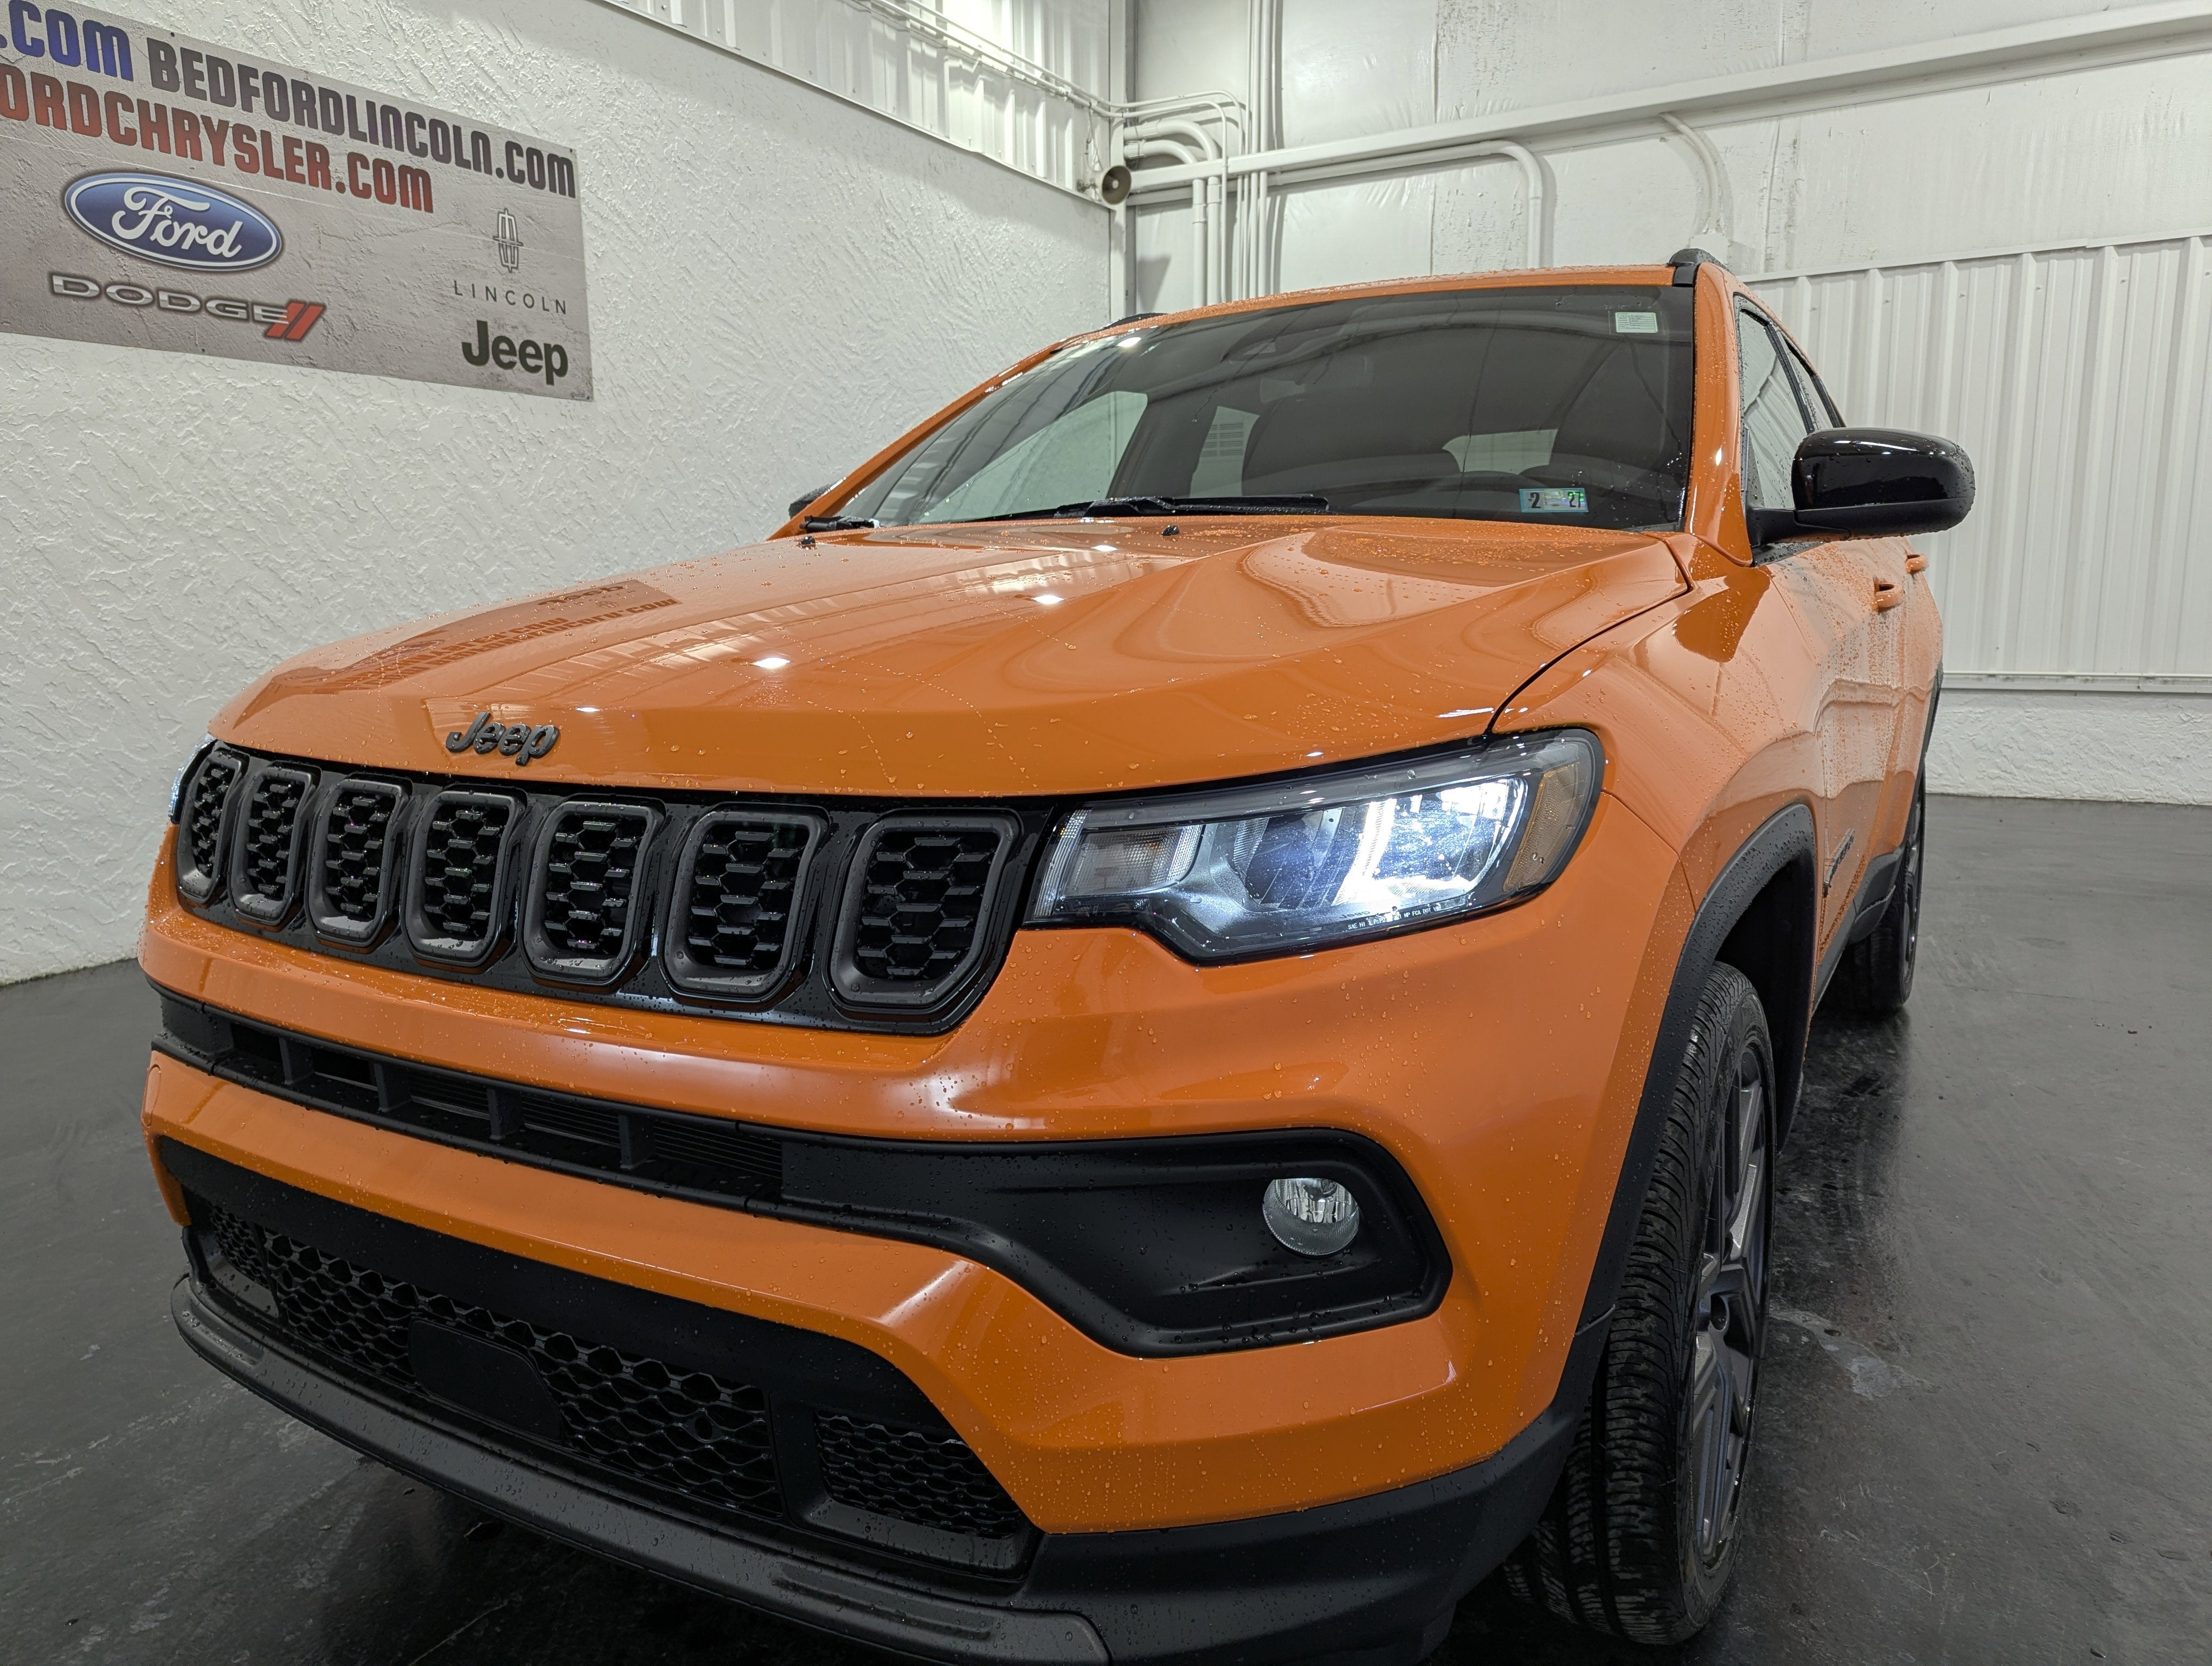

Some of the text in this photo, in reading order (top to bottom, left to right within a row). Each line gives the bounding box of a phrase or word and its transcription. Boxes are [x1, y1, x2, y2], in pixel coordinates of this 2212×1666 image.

[146, 37, 576, 198] BEDFORDLINCOLN.COM
[112, 186, 243, 258] Ford
[52, 274, 290, 324] DODGE
[454, 280, 567, 315] LINCOLN
[462, 319, 569, 386] Jeep
[1530, 492, 1541, 508] 2
[446, 712, 560, 766] Jeep
